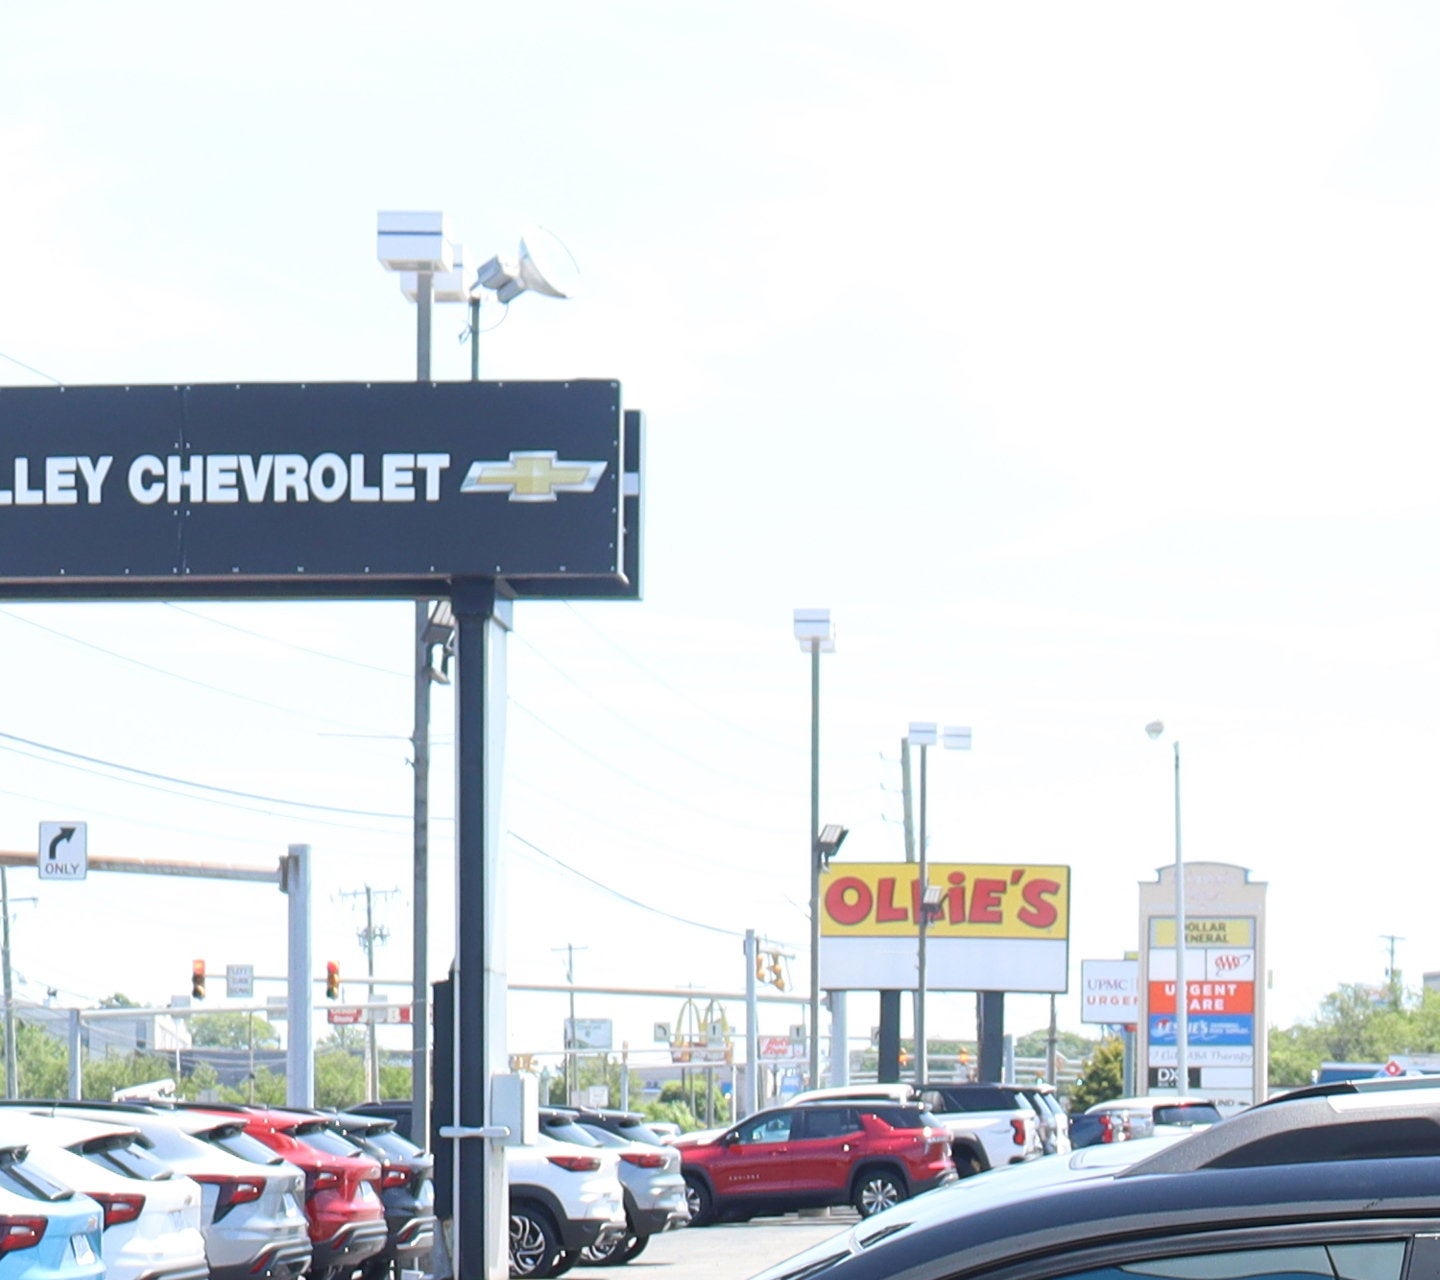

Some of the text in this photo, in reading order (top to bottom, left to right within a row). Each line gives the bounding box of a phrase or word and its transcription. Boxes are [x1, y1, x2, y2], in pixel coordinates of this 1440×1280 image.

[127, 452, 451, 504] CHEVROLET
[45, 862, 80, 875] ONLY
[1184, 921, 1227, 933] OLLAR
[1184, 933, 1230, 944] ENERAL
[1086, 978, 1128, 991] UPMC
[1164, 983, 1238, 997] UGENT
[1186, 998, 1225, 1011] ARE
